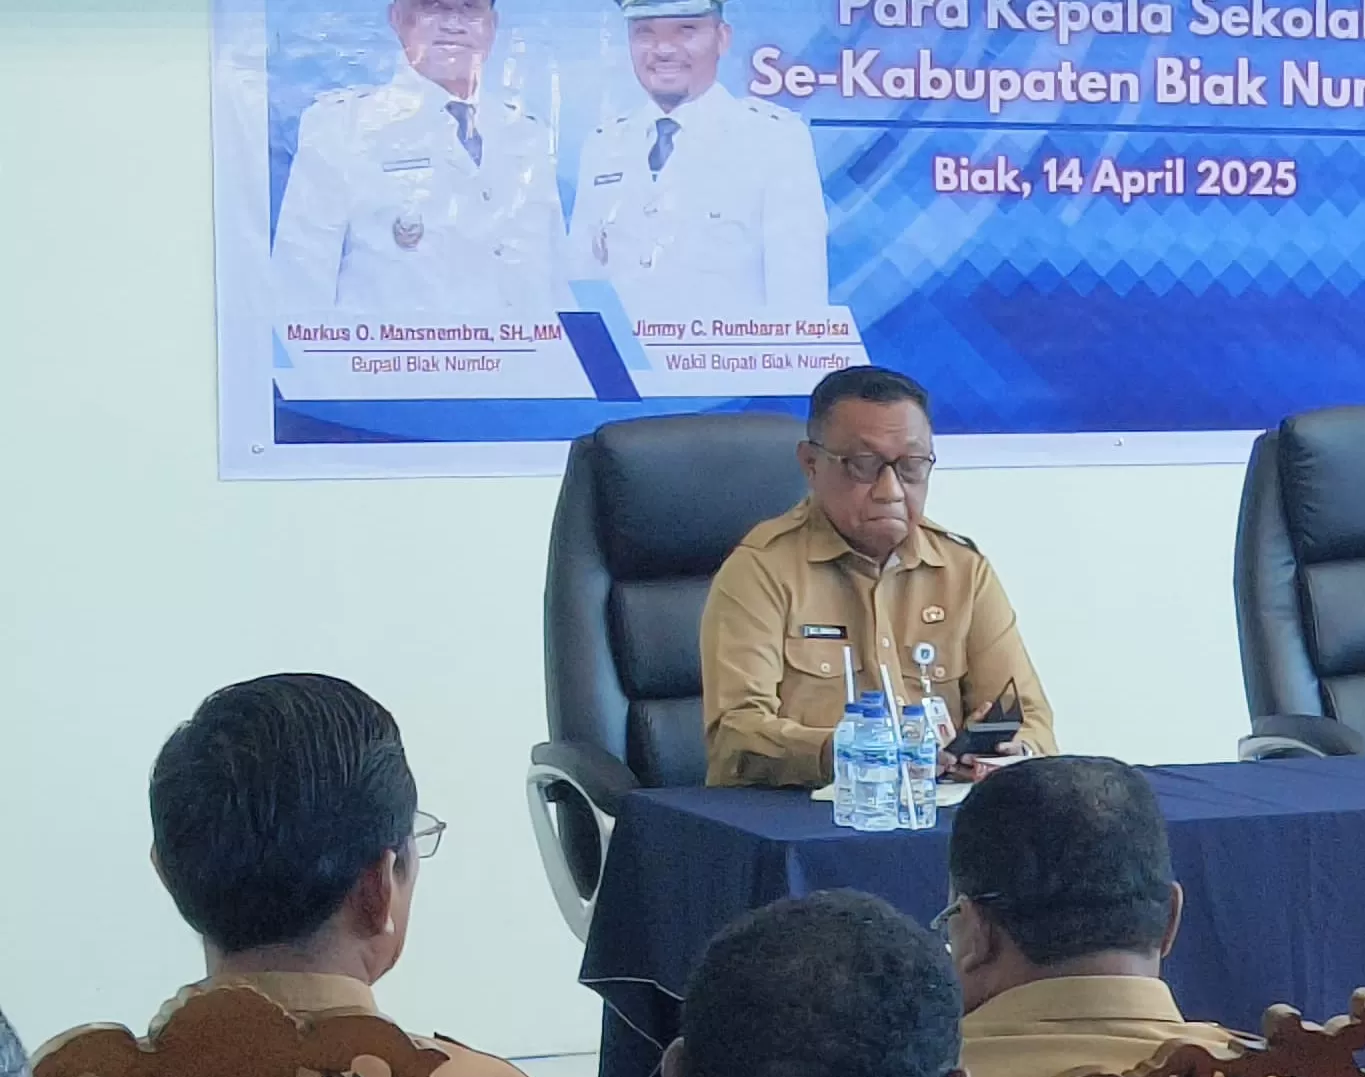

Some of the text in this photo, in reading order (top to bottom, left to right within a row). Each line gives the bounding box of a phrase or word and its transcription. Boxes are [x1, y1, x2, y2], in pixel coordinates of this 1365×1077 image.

[839, 0, 969, 28] Para
[987, 0, 1172, 45] Kepala
[749, 47, 1140, 114] Se-Kabupaten
[1156, 56, 1268, 106] Biak
[933, 155, 1297, 204] Biak, 14 April 2025
[287, 323, 350, 342] Markus
[355, 323, 375, 342] O.
[632, 319, 686, 340] Jimmy
[690, 319, 708, 337] C.
[351, 355, 402, 375] Bupati
[406, 355, 439, 372] Biak
[711, 353, 758, 373] Bupati
[761, 352, 793, 370] Biak
